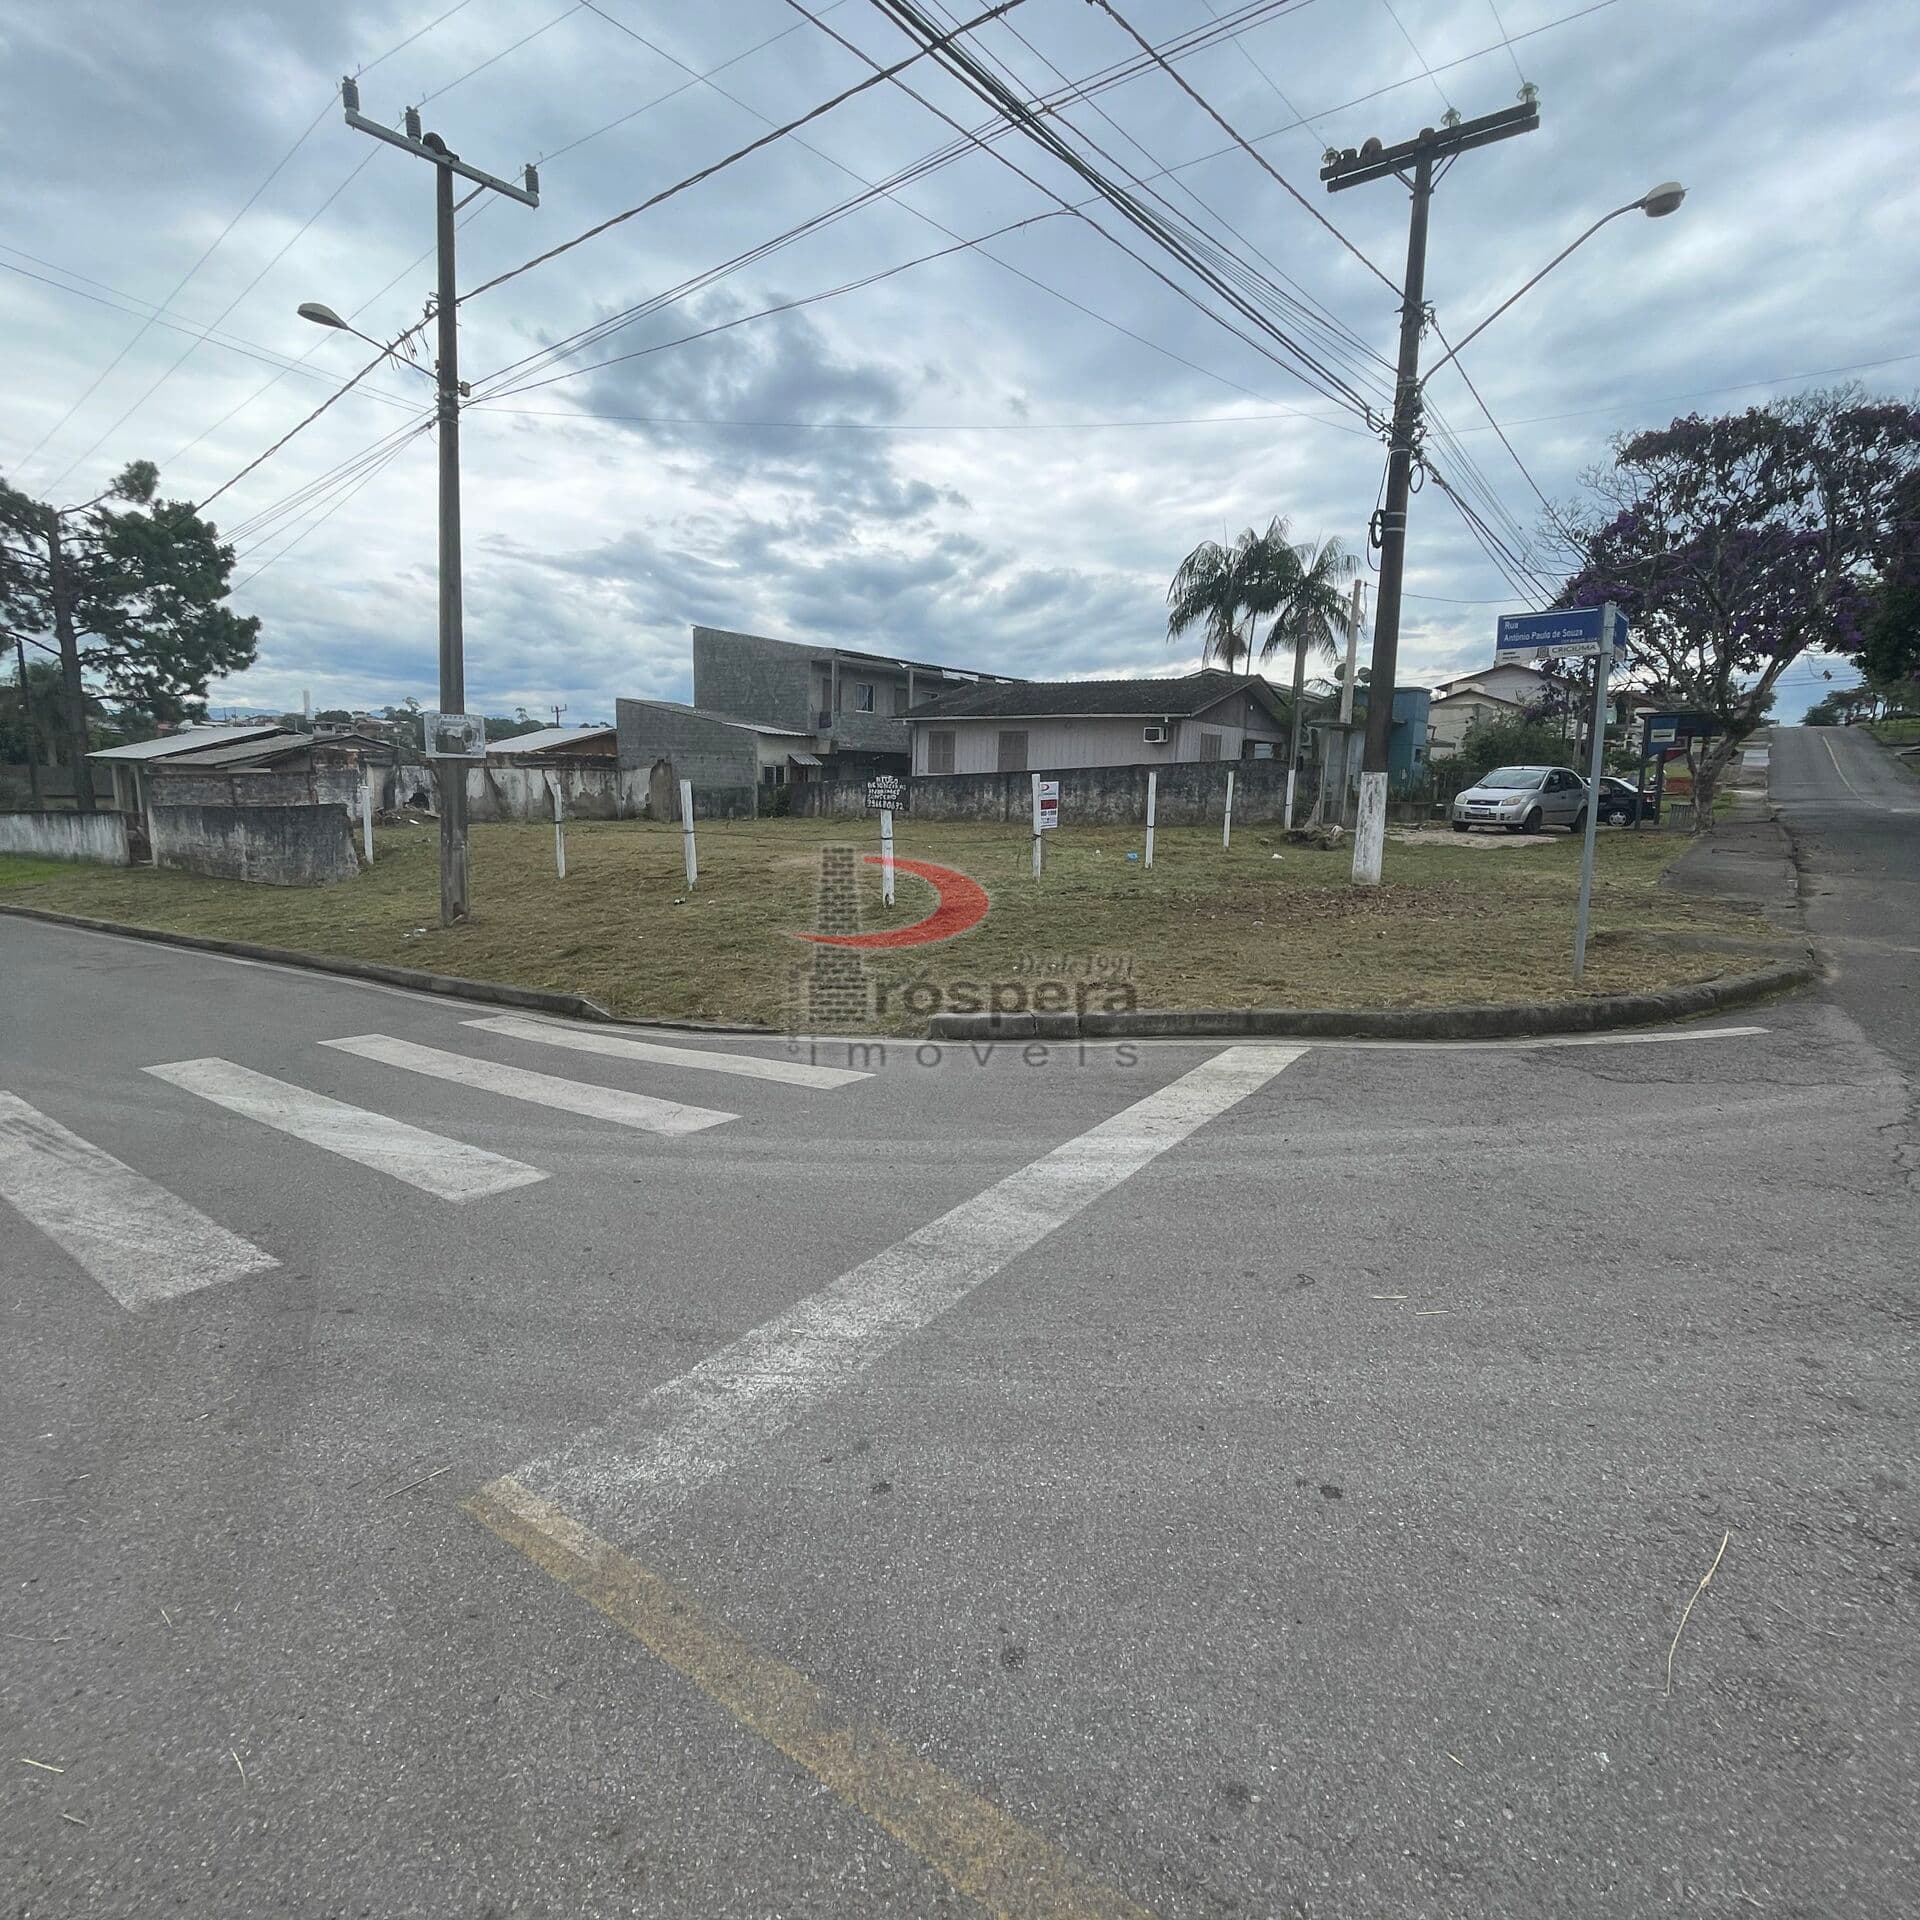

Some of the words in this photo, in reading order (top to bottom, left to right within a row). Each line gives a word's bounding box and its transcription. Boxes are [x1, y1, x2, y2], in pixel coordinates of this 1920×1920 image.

[1504, 621, 1519, 630] Rua
[1531, 631, 1551, 640] Paulo
[1552, 630, 1561, 638] de
[1562, 628, 1583, 637] Souza
